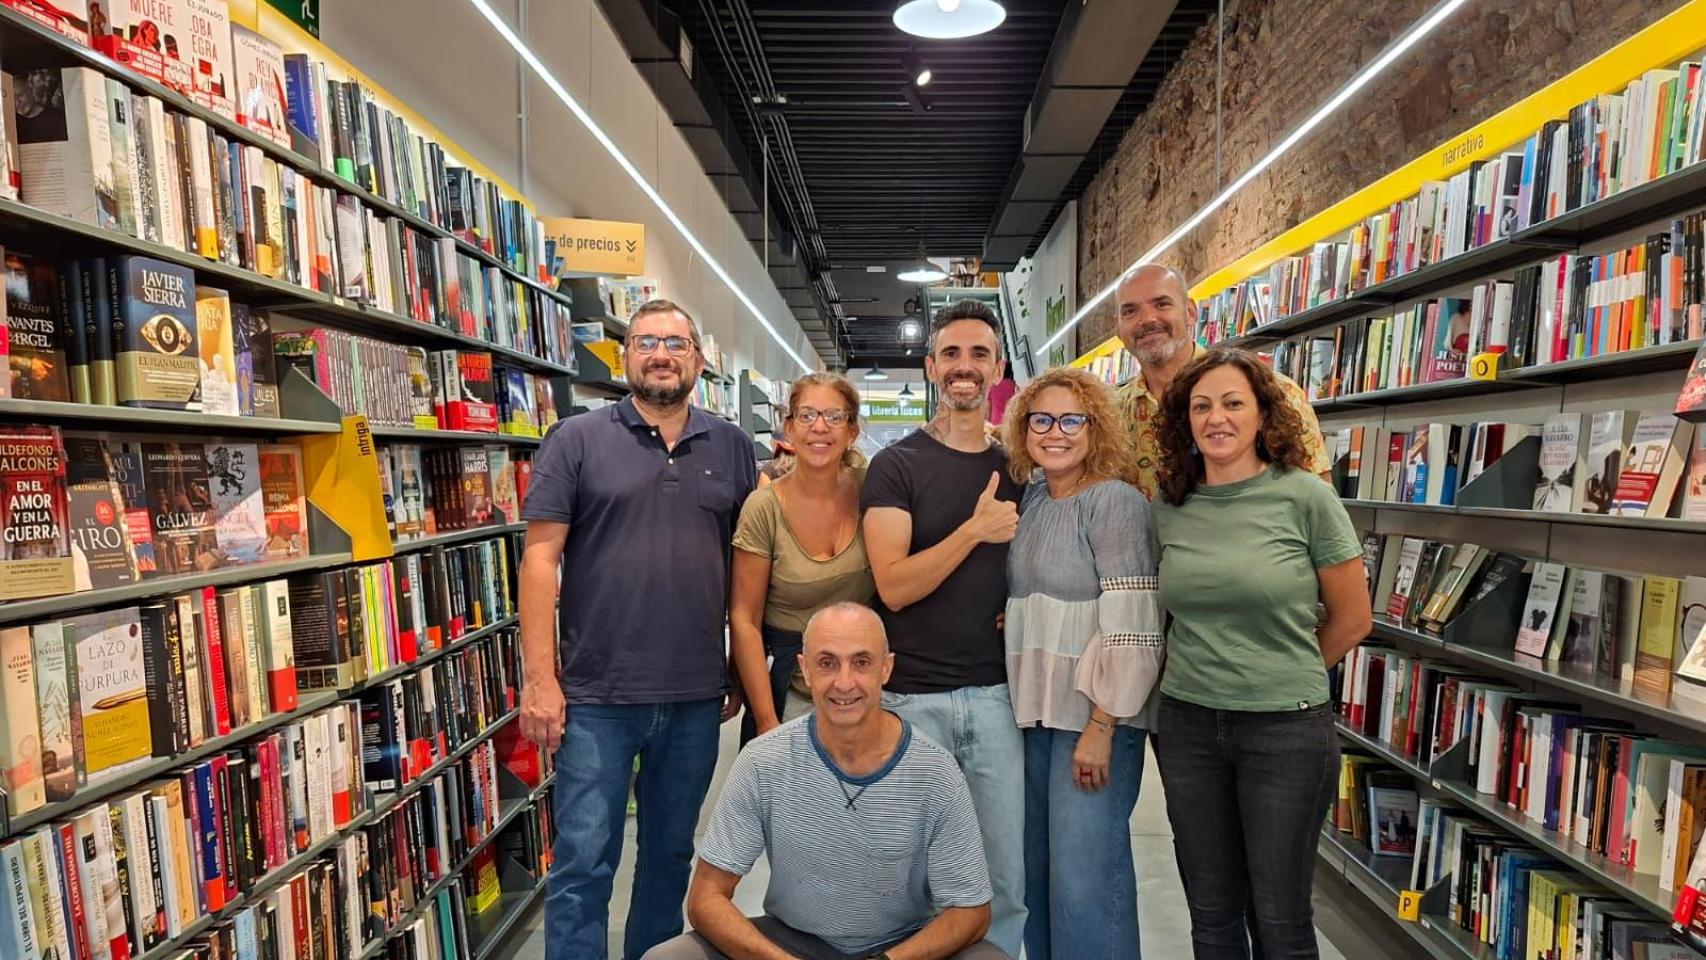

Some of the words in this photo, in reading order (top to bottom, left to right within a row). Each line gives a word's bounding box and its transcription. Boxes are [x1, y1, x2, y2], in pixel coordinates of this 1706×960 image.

[190, 15, 213, 39] OBA
[192, 34, 218, 62] EGRA
[1443, 133, 1484, 166] narrativa
[559, 233, 573, 248] de
[577, 237, 621, 252] precios
[142, 269, 184, 293] JAVIER
[143, 287, 186, 309] SIERRA
[6, 316, 54, 333] RVANTES
[151, 358, 168, 369] PLAN
[1435, 350, 1464, 361] JUST
[1476, 359, 1488, 376] O
[253, 385, 275, 403] UILES
[356, 421, 372, 457] intriga
[0, 457, 60, 472] ALCONES
[114, 457, 135, 470] AÚL
[464, 461, 488, 473] HARRIS
[16, 481, 30, 492] EN
[31, 480, 43, 491] EL
[9, 494, 52, 511] AMOR
[264, 503, 299, 513] ORAZONES
[13, 514, 22, 524] Y
[23, 513, 36, 524] EN
[37, 511, 50, 523] LA
[156, 511, 208, 529] GÁLVEZ
[3, 524, 61, 543] GUERRA
[89, 640, 126, 660] LAZO
[103, 660, 114, 670] DE
[10, 856, 26, 905] SEPULTURERO
[67, 854, 80, 905] CORTESANA
[74, 905, 82, 917] LA
[1402, 897, 1412, 911] P
[17, 906, 28, 920] DEL
[21, 920, 31, 943] LIBRO
[24, 943, 32, 953] EL
